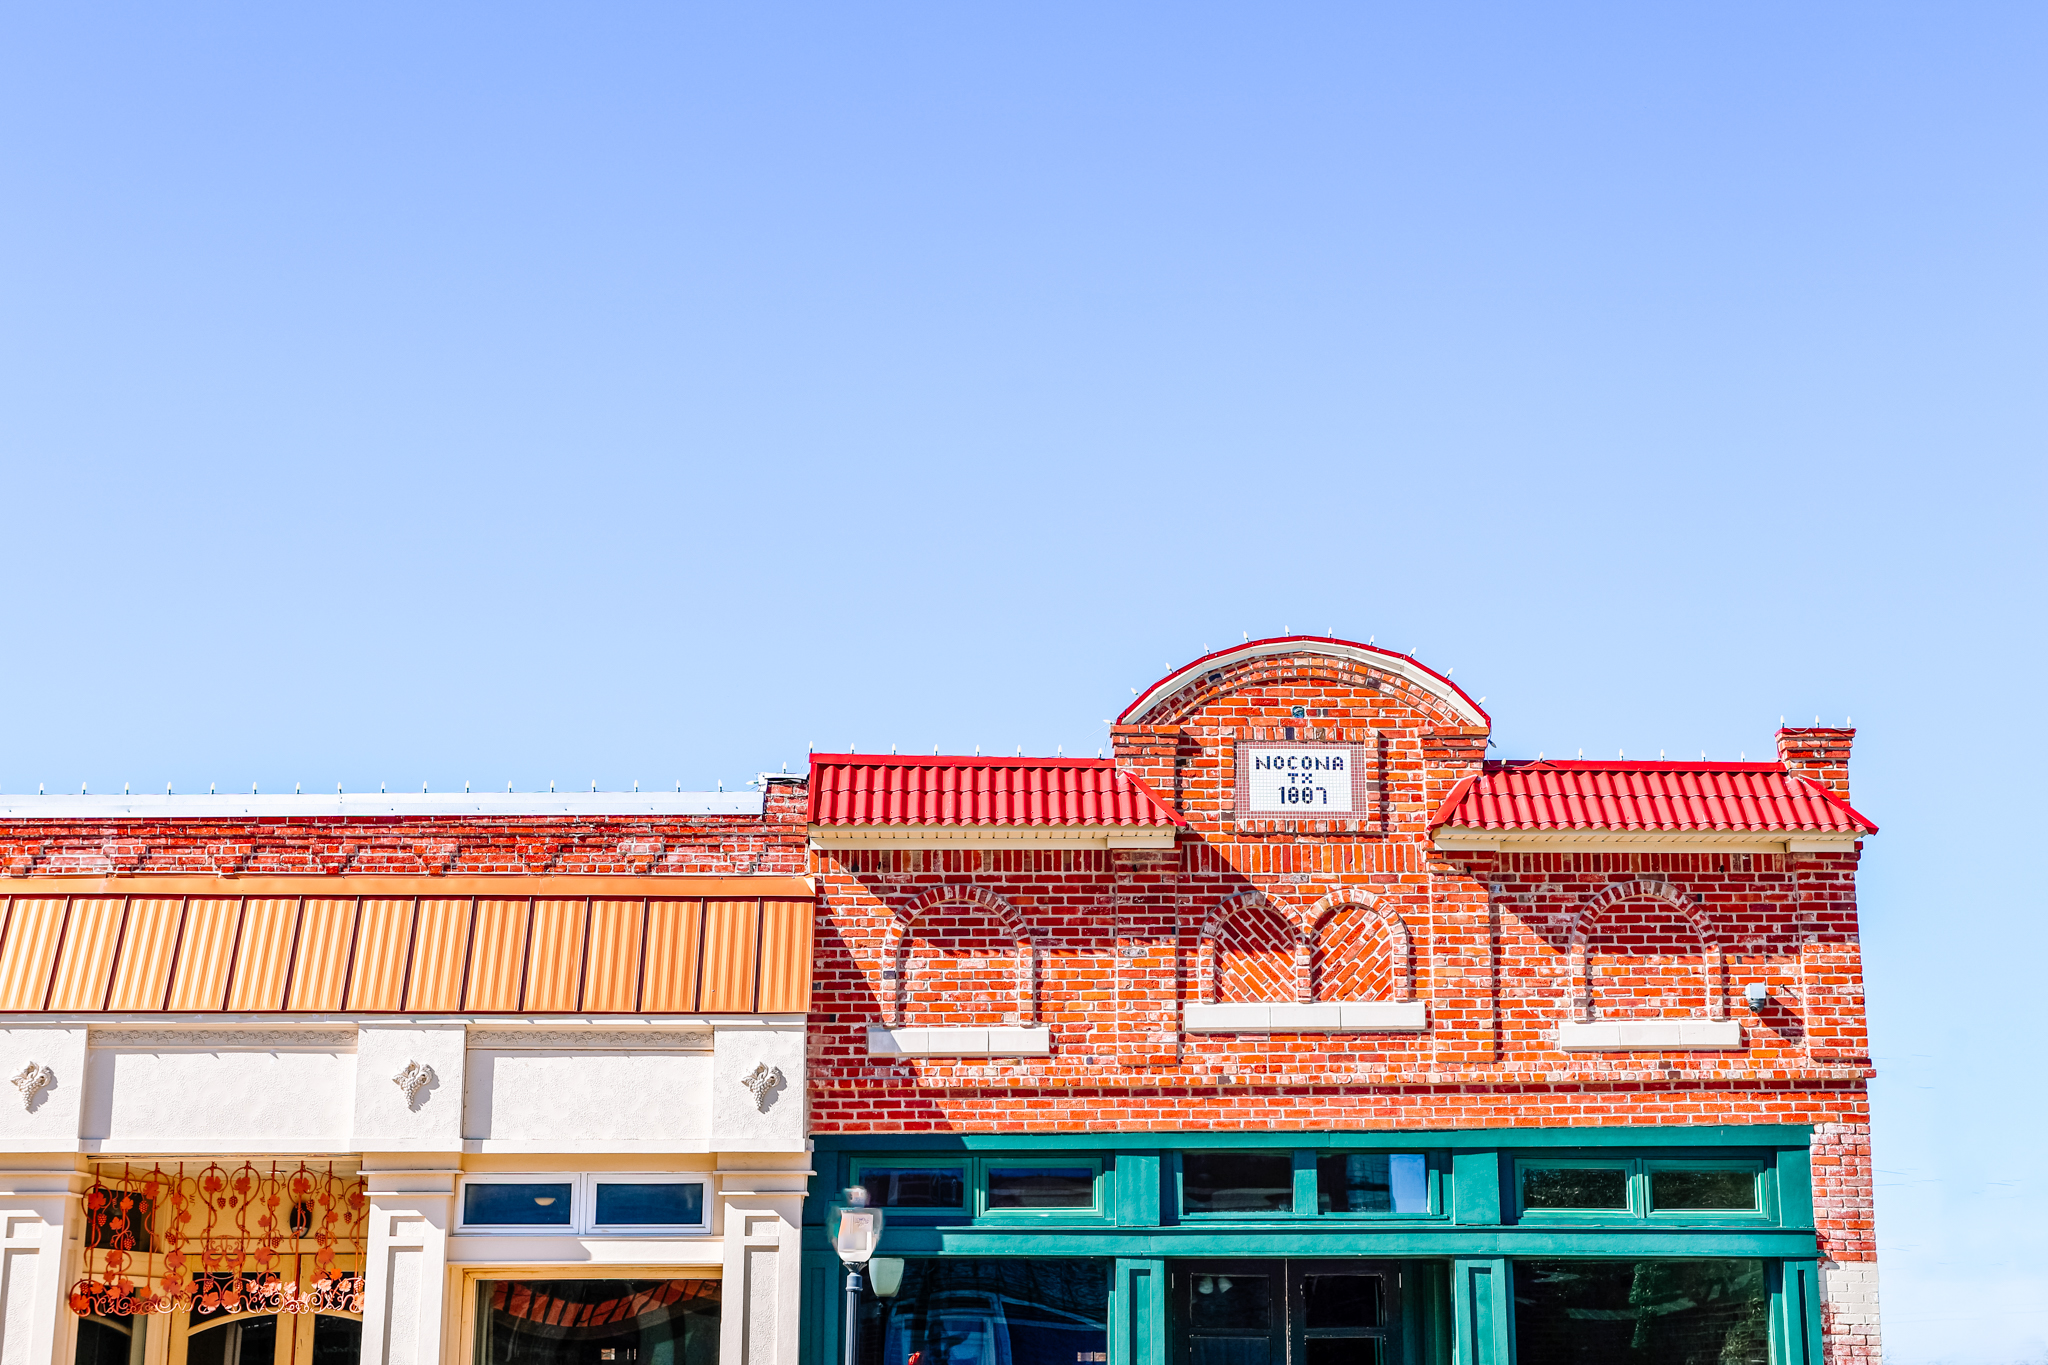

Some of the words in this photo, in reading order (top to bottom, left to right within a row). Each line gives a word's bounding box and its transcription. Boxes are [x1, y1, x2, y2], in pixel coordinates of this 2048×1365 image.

[1255, 756, 1344, 770] NOCONA
[1287, 773, 1313, 784] TX
[1278, 786, 1328, 805] 1887
